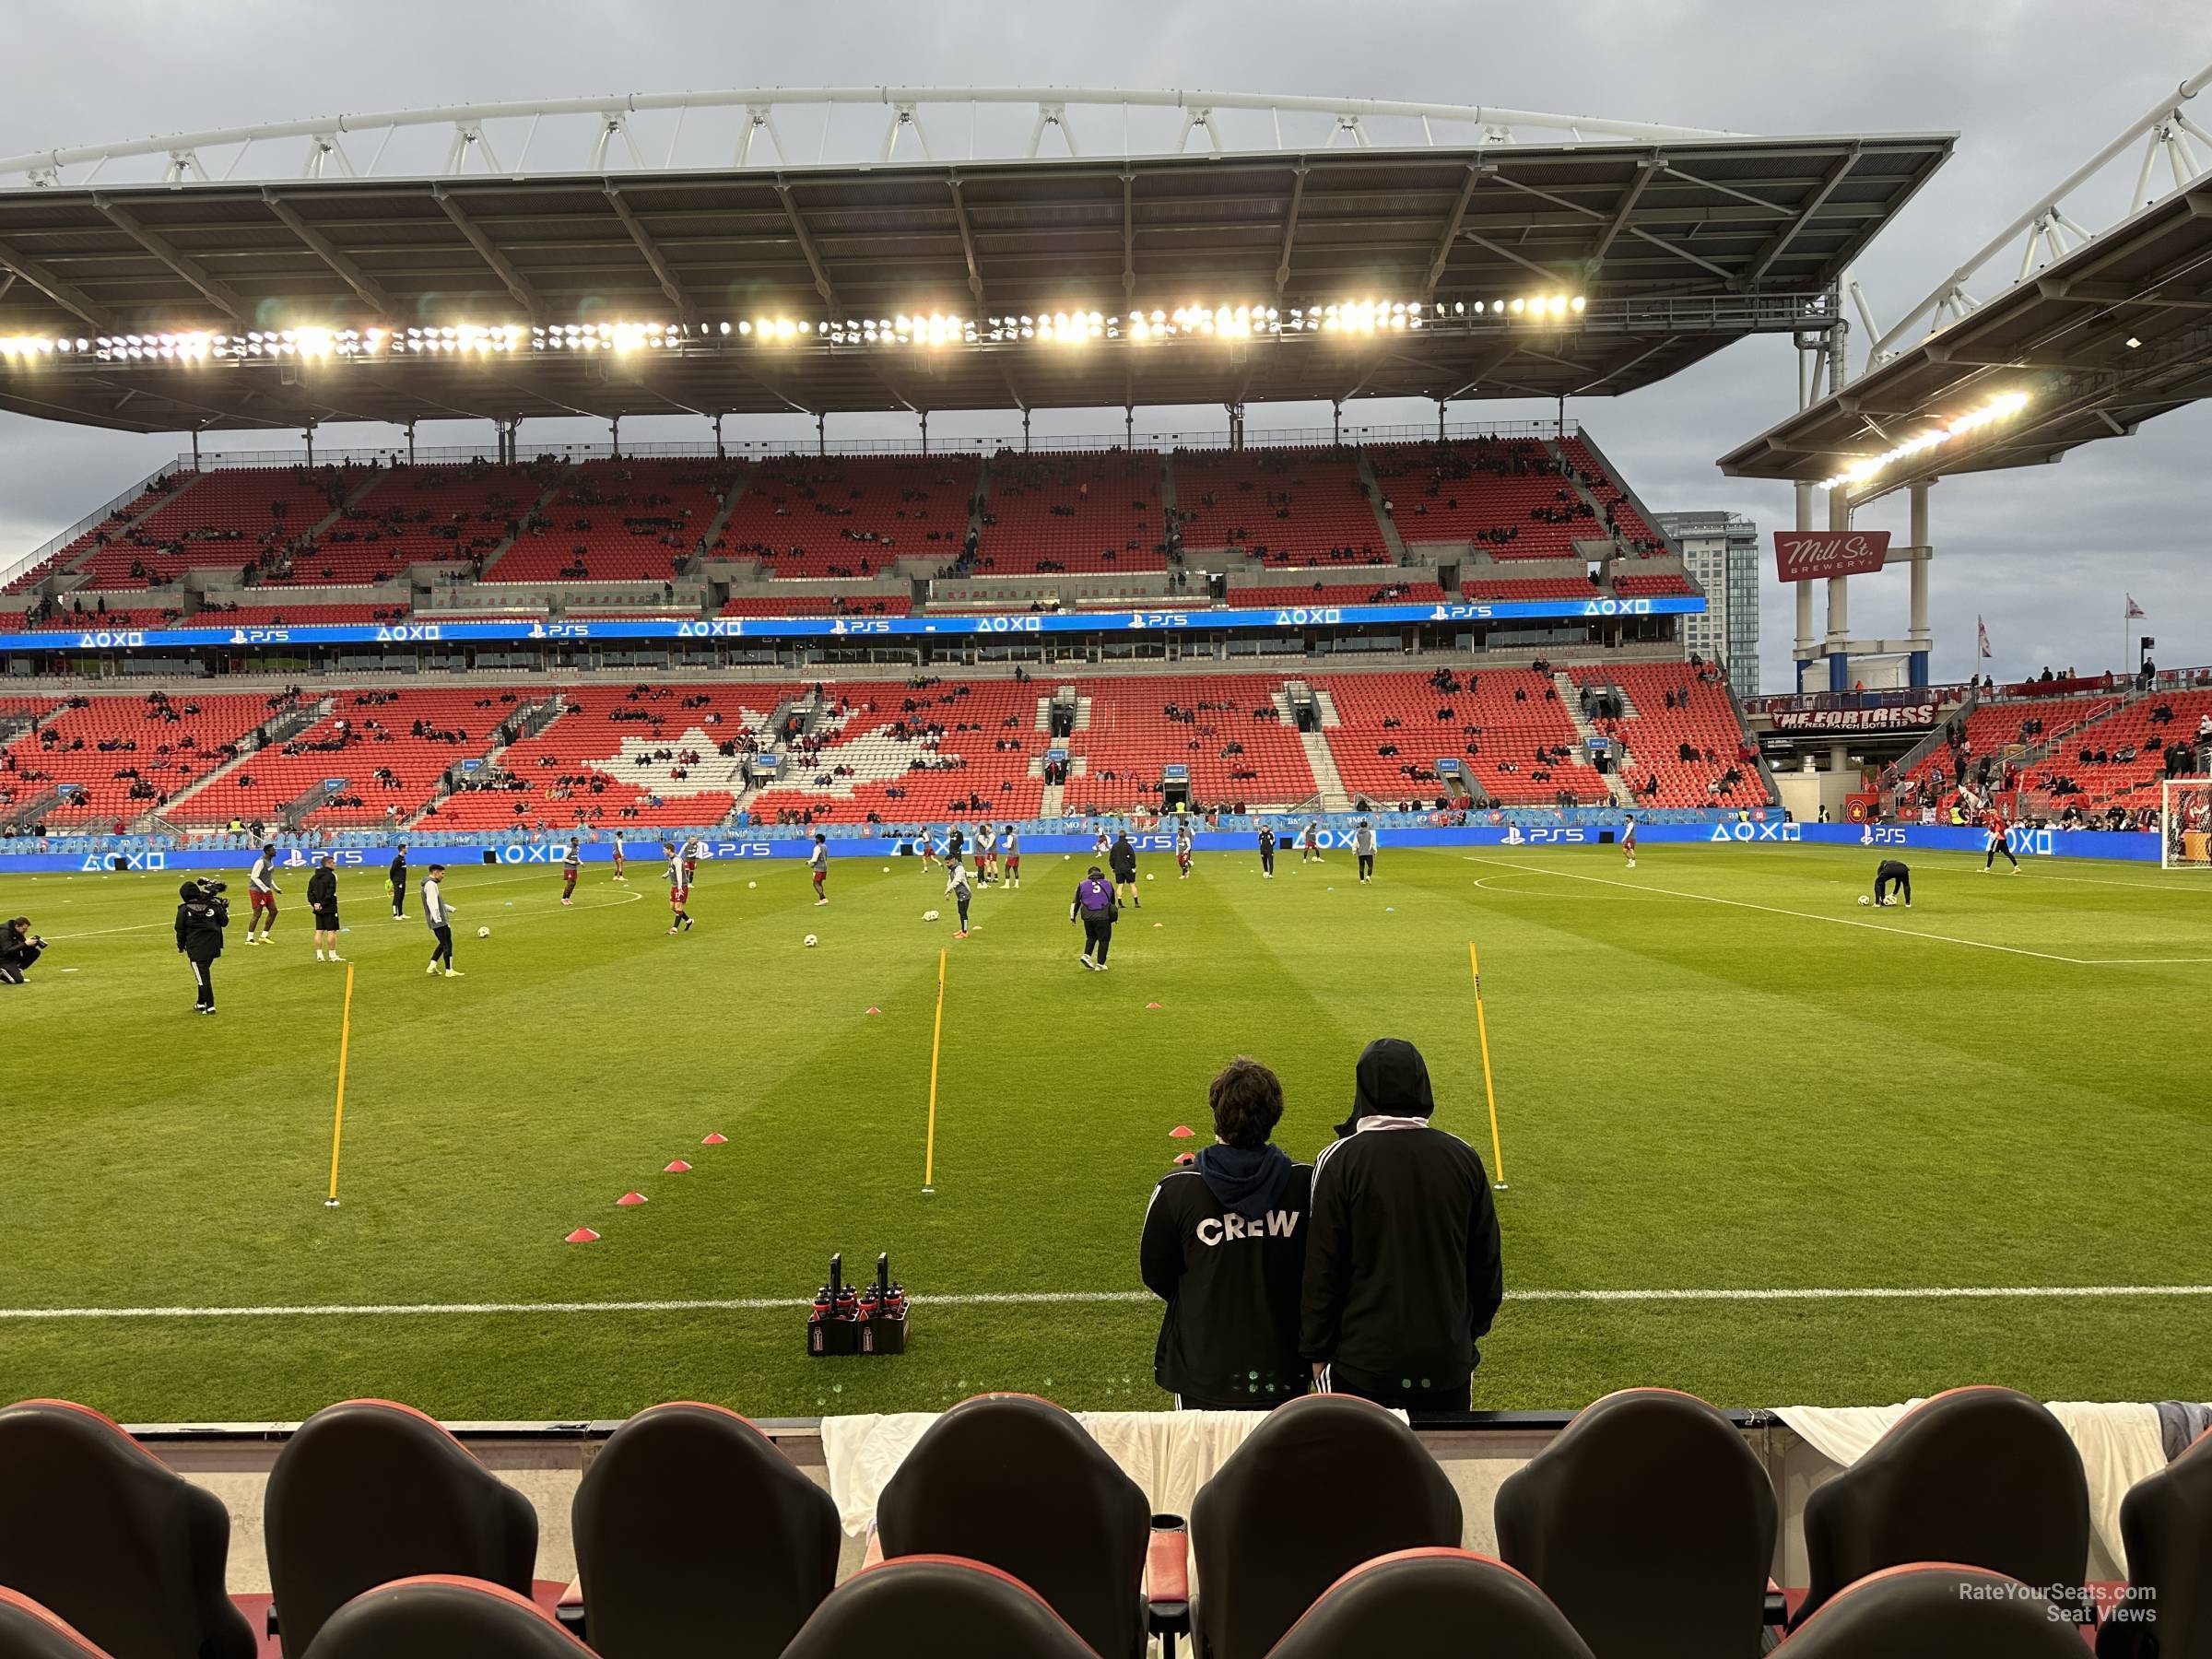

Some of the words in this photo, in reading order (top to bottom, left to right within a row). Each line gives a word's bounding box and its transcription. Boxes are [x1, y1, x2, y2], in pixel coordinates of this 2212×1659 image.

[1783, 539, 1841, 565] Mill
[1841, 535, 1874, 559] St.
[1791, 559, 1865, 574] BREWERY
[1452, 606, 1492, 618] PS5
[852, 621, 889, 632] PS5
[1149, 615, 1188, 626] PS5
[250, 630, 289, 641] PS5
[549, 625, 588, 635] PS5
[1772, 712, 1810, 728] THE
[1814, 704, 1934, 724] FORTRESS
[1531, 829, 1584, 841] PS5
[1876, 828, 1906, 843] PS5
[719, 843, 771, 855] PS5
[1196, 1210, 1300, 1246] CREW
